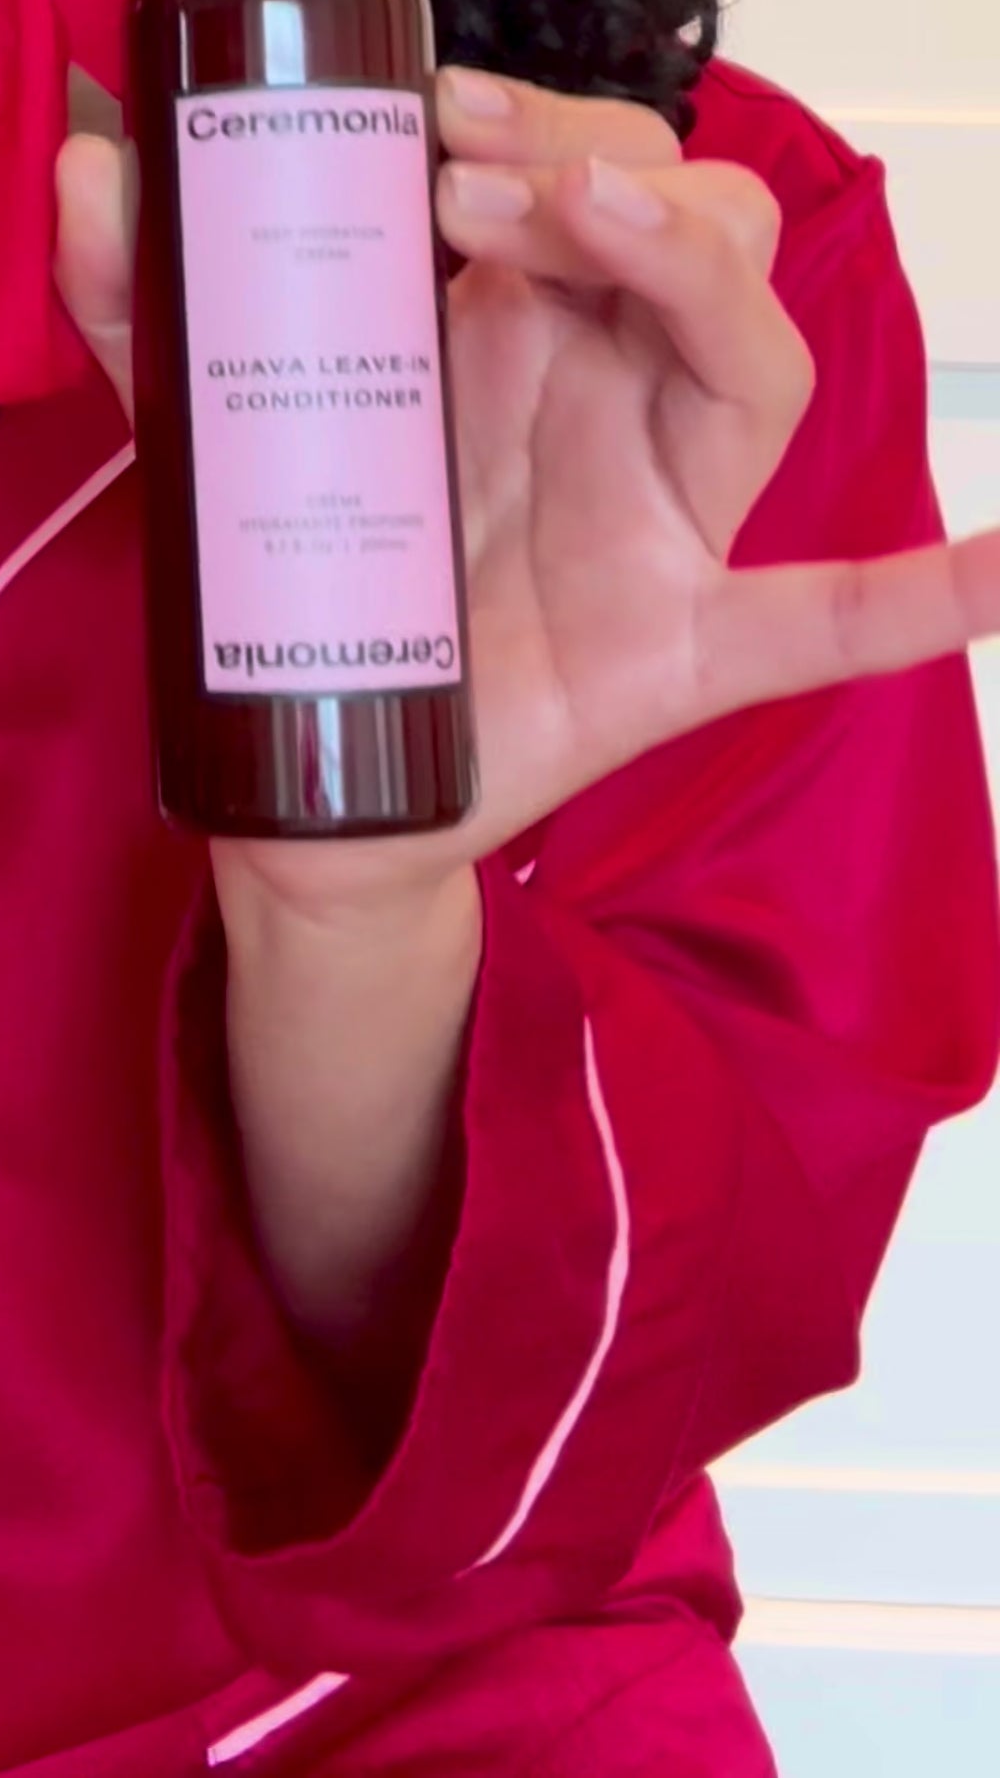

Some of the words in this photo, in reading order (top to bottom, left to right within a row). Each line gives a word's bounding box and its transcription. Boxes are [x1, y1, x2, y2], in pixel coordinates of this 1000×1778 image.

[187, 103, 420, 141] Ceremonia
[207, 358, 307, 379] GUAVA
[317, 353, 431, 375] LEAVE-IN
[225, 387, 422, 412] CONDITIONER
[213, 634, 455, 678] Ceremonia
